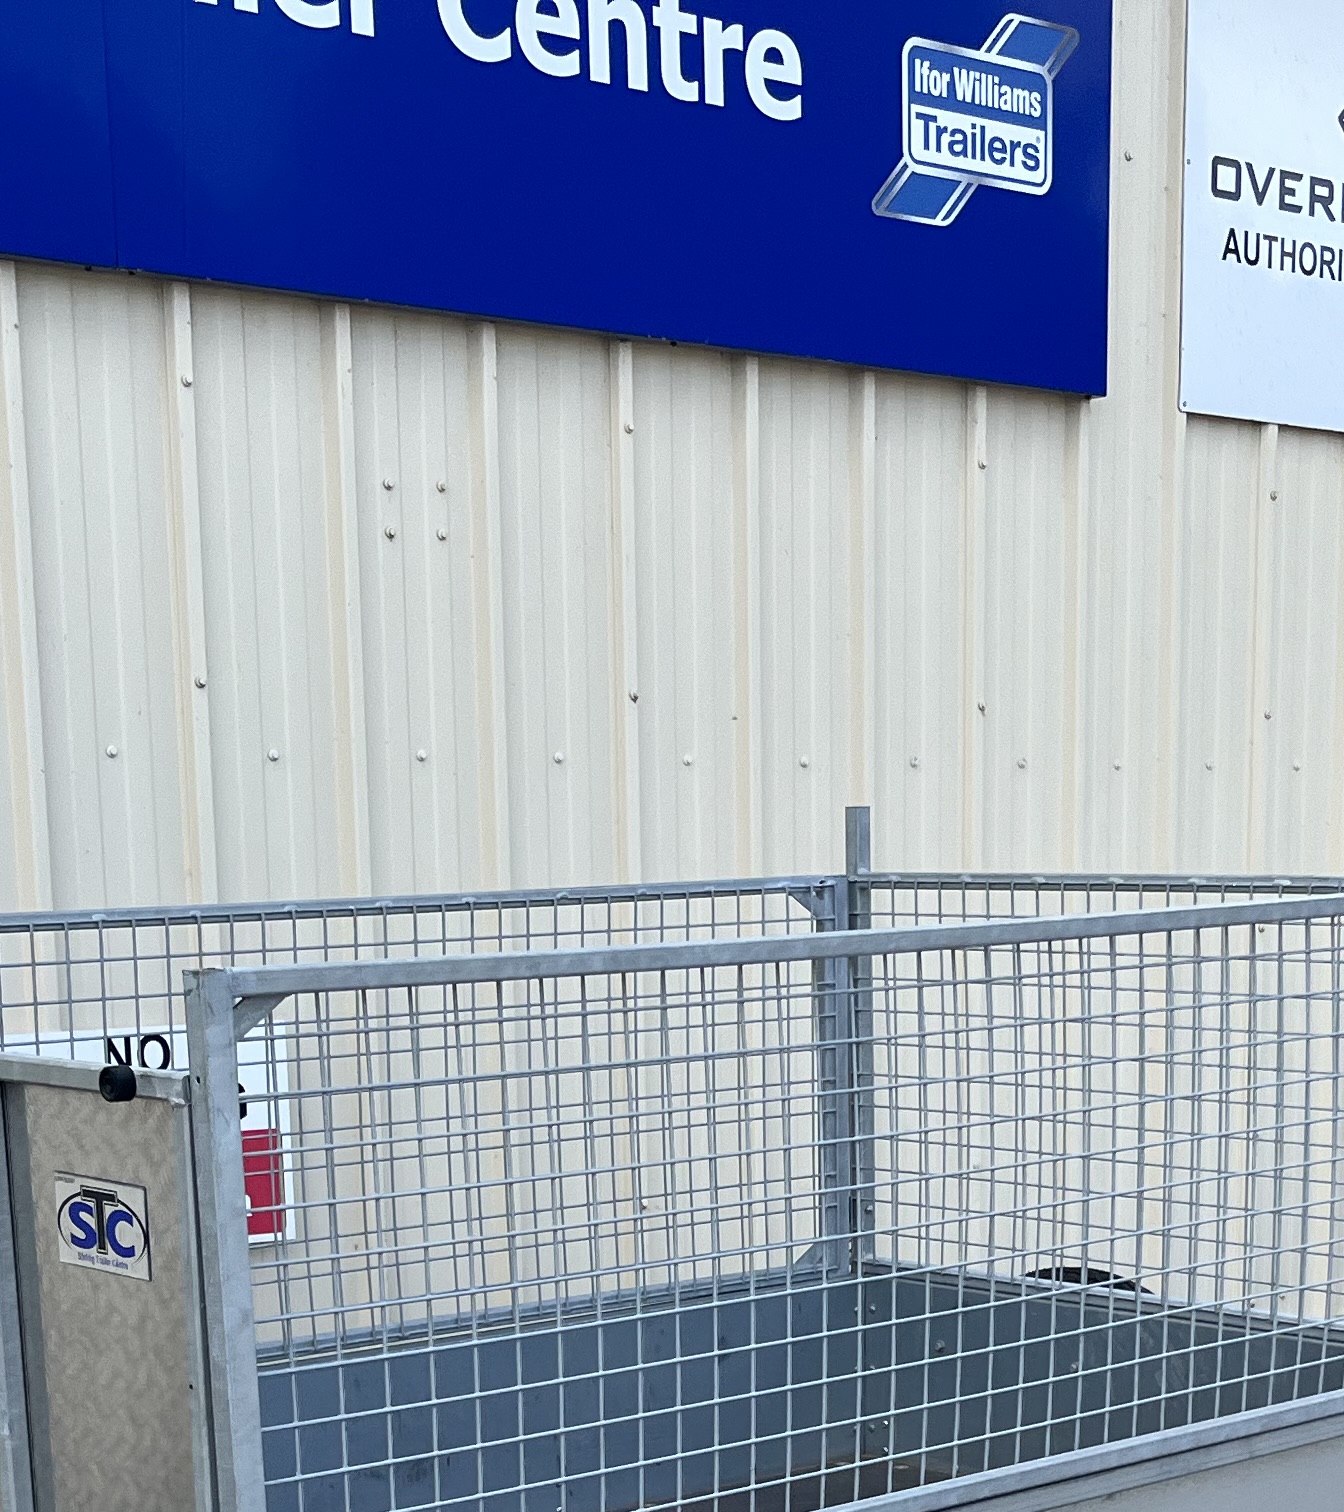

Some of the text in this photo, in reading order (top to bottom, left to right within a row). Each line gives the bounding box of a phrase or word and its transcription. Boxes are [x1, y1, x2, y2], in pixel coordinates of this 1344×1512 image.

[913, 58, 1042, 118] Ifor Williams
[915, 112, 1041, 172] Trailers
[106, 1034, 171, 1070] NO
[68, 1184, 136, 1258] STC
